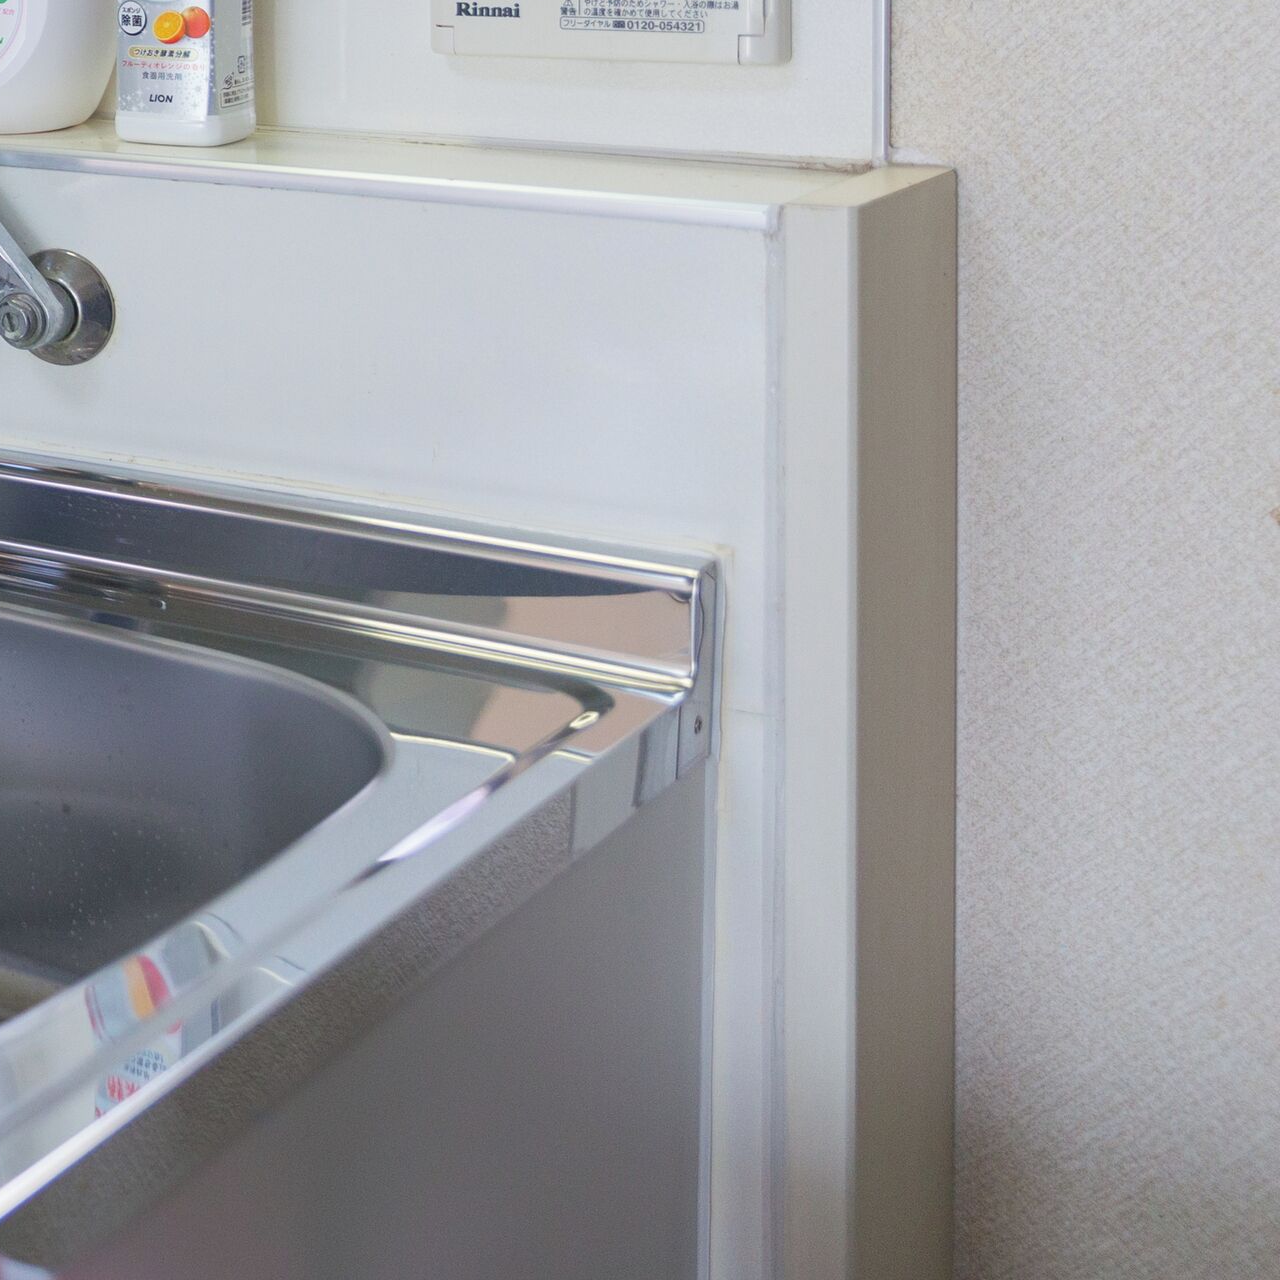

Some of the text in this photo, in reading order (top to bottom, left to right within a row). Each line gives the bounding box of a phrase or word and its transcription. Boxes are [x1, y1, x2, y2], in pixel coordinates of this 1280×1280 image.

[455, 1, 521, 18] Rinnai
[560, 6, 577, 16] 警告
[121, 14, 143, 27] 除菌
[562, 18, 702, 31] フリーダイヤル 0120-054321
[149, 94, 174, 103] LION
